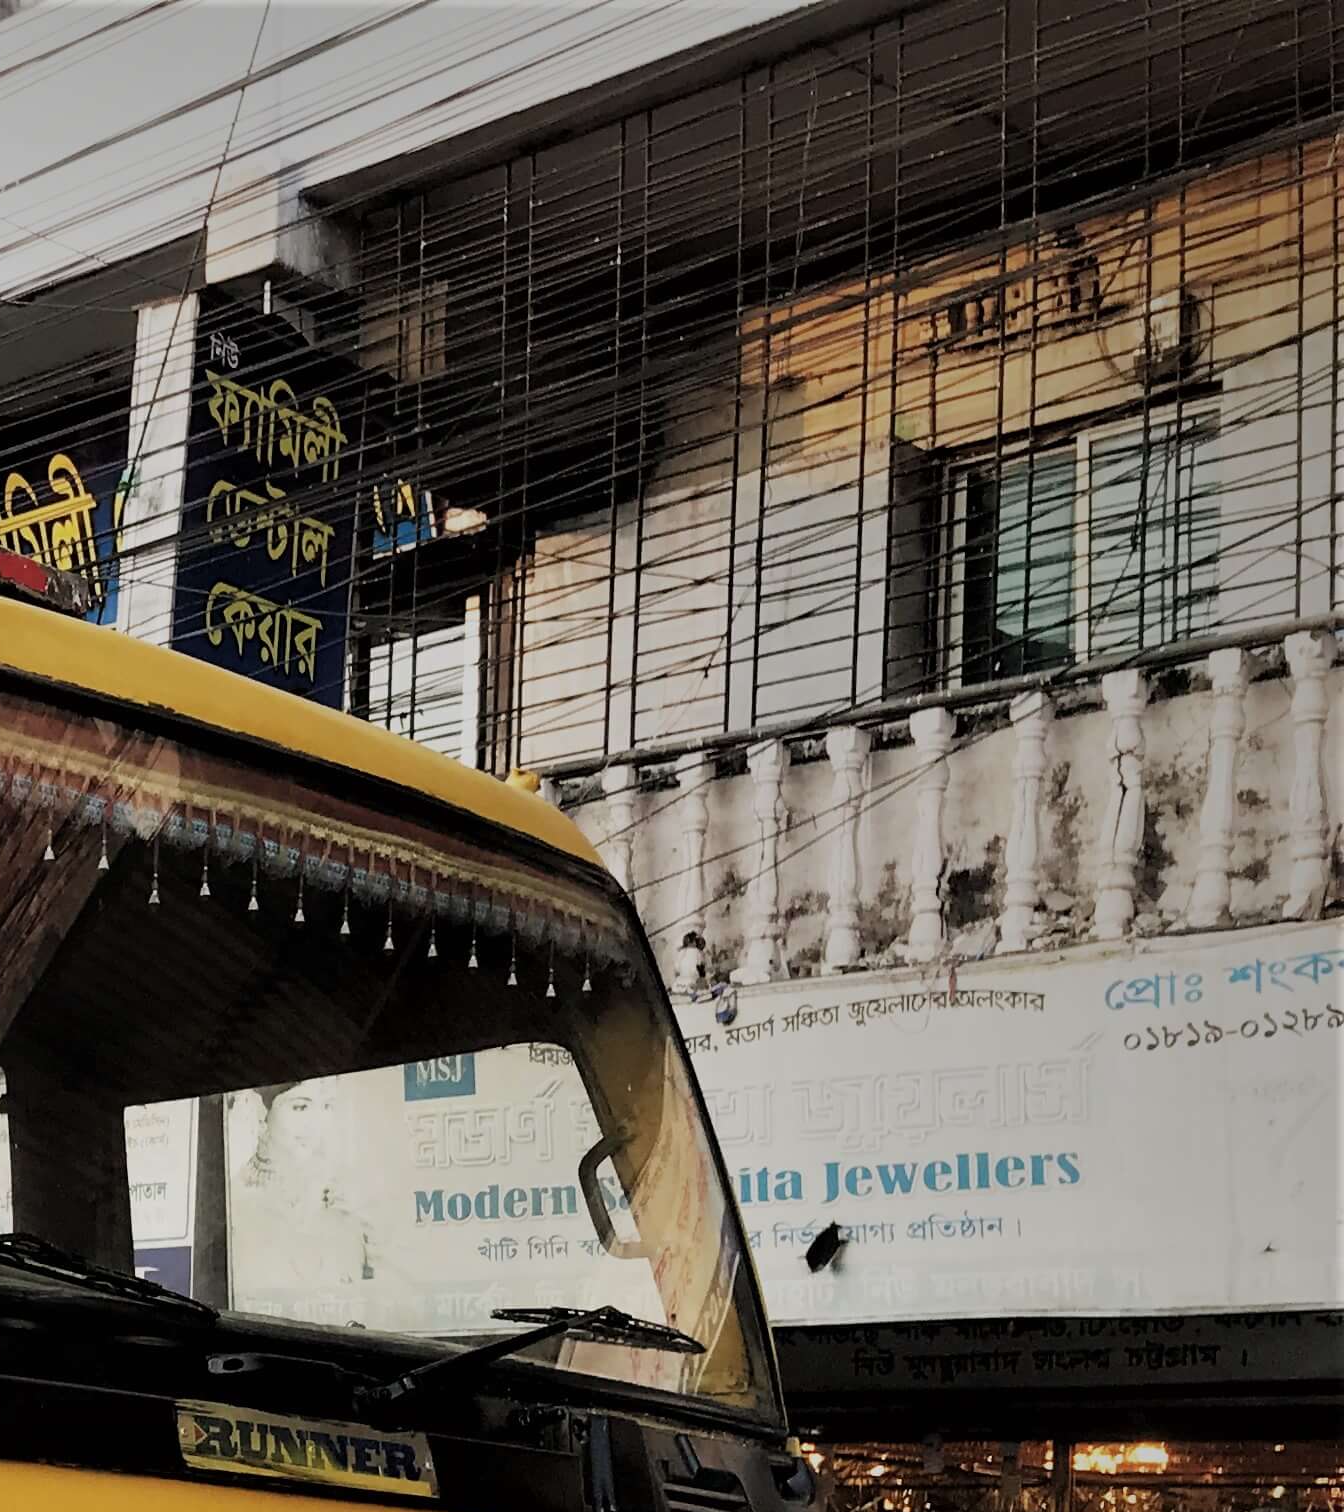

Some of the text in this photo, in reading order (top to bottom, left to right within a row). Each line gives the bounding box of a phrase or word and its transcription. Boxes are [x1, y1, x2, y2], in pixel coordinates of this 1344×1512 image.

[206, 581, 323, 683] কেয়ার
[1223, 948, 1344, 993] শংক
[413, 1183, 578, 1226] Modern
[823, 1151, 1082, 1206] Jewellers
[190, 1414, 421, 1482] RUNNER
